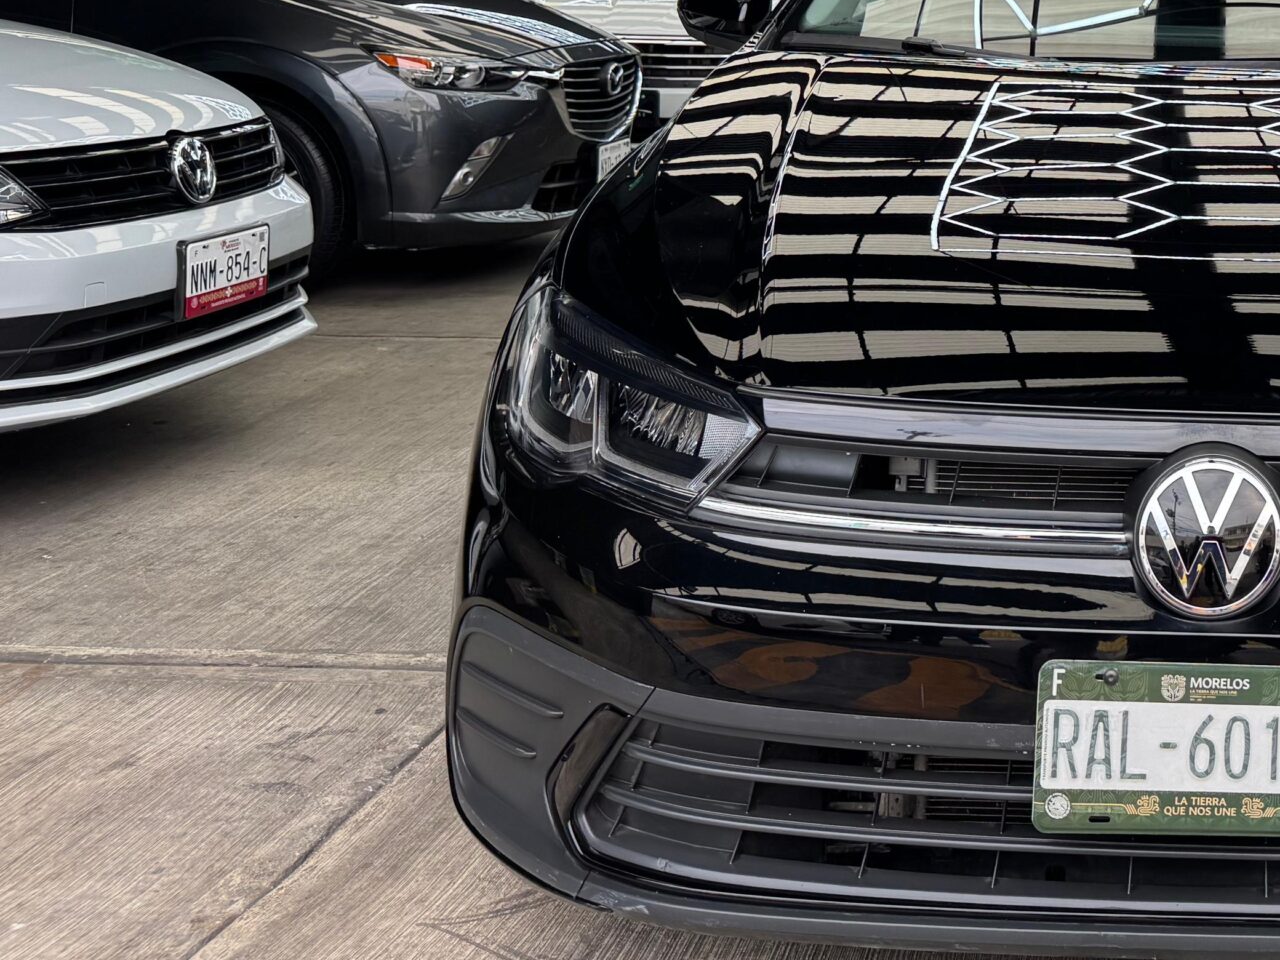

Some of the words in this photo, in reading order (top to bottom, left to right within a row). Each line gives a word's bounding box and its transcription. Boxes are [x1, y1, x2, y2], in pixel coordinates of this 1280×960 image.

[190, 246, 267, 295] NNM-854-C
[1052, 668, 1066, 696] F
[1189, 676, 1251, 690] MORELOS
[1174, 796, 1188, 806] LA
[1190, 796, 1227, 807] TIERRA
[1163, 805, 1186, 817] QUE
[1188, 806, 1212, 816] NOS
[1214, 807, 1237, 817] UNE
